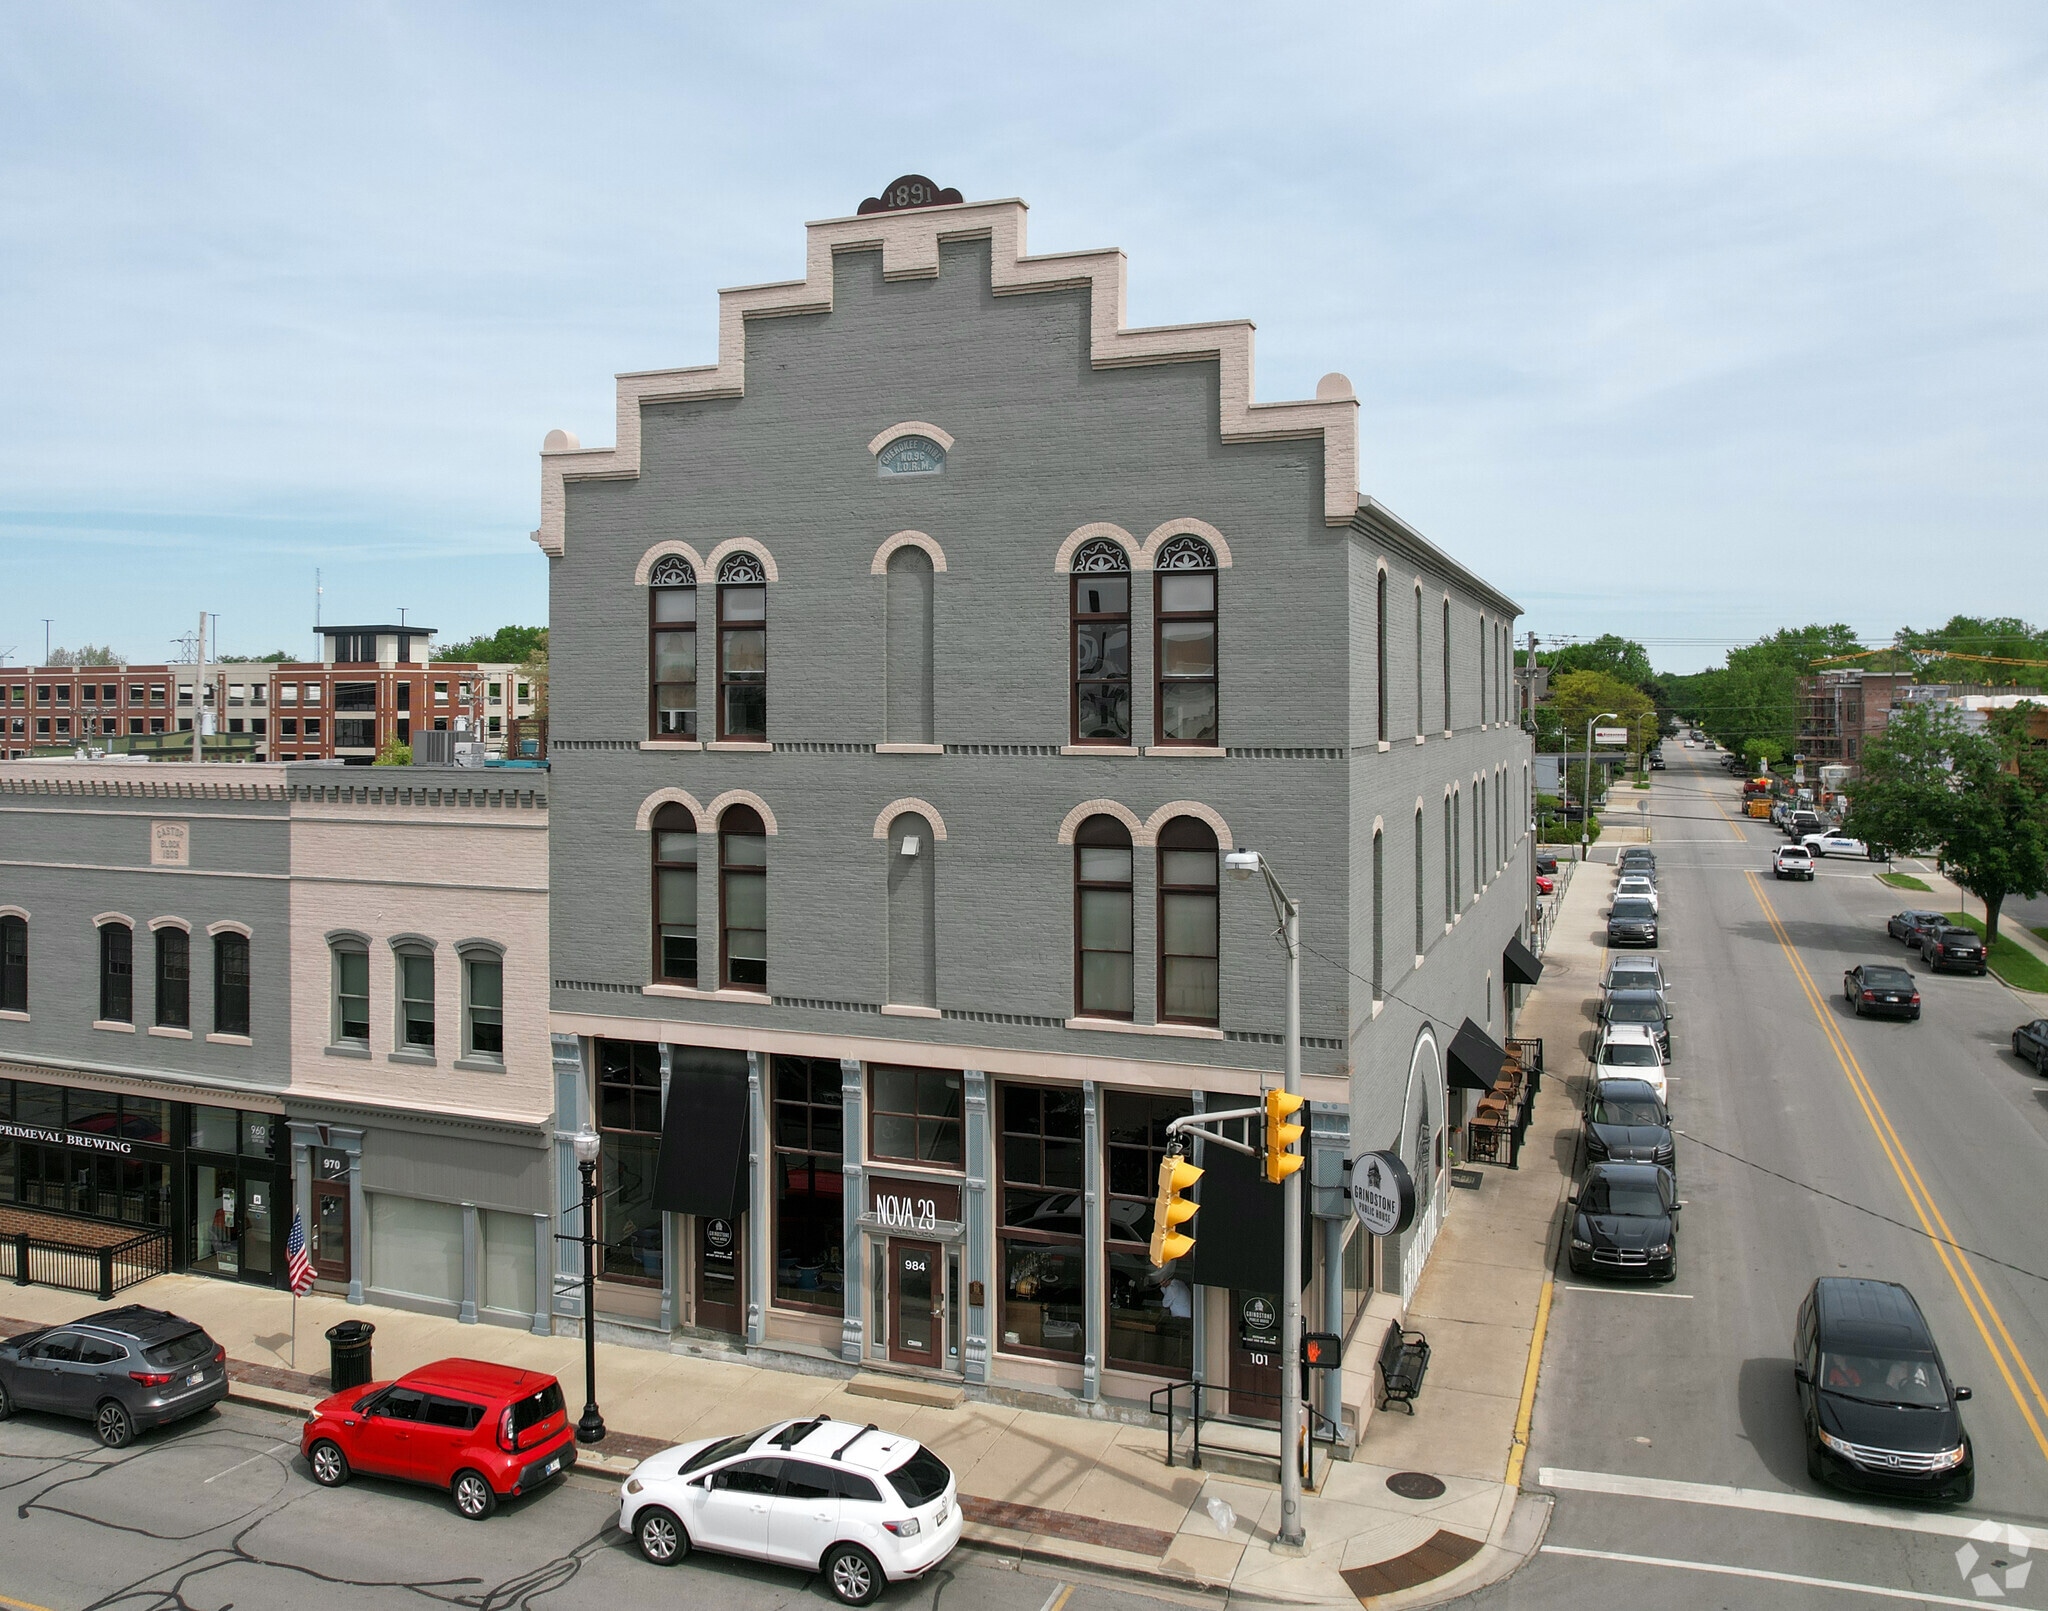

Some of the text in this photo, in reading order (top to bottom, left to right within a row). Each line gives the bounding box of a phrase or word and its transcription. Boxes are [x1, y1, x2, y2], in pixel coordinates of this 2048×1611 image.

[888, 183, 932, 207] 1891
[882, 440, 943, 465] CHEROKEE TRIBE
[0, 1124, 132, 1153] PRIMEVAL BREWING
[250, 1124, 266, 1136] 960
[323, 1158, 341, 1170] 970
[1354, 1184, 1396, 1214] GRINDSTONE
[876, 1193, 936, 1231] NOVA 29
[1358, 1201, 1375, 1216] PUBLIC
[1375, 1209, 1391, 1224] HOUSE
[904, 1259, 926, 1272] 984
[1250, 1352, 1269, 1366] 101
